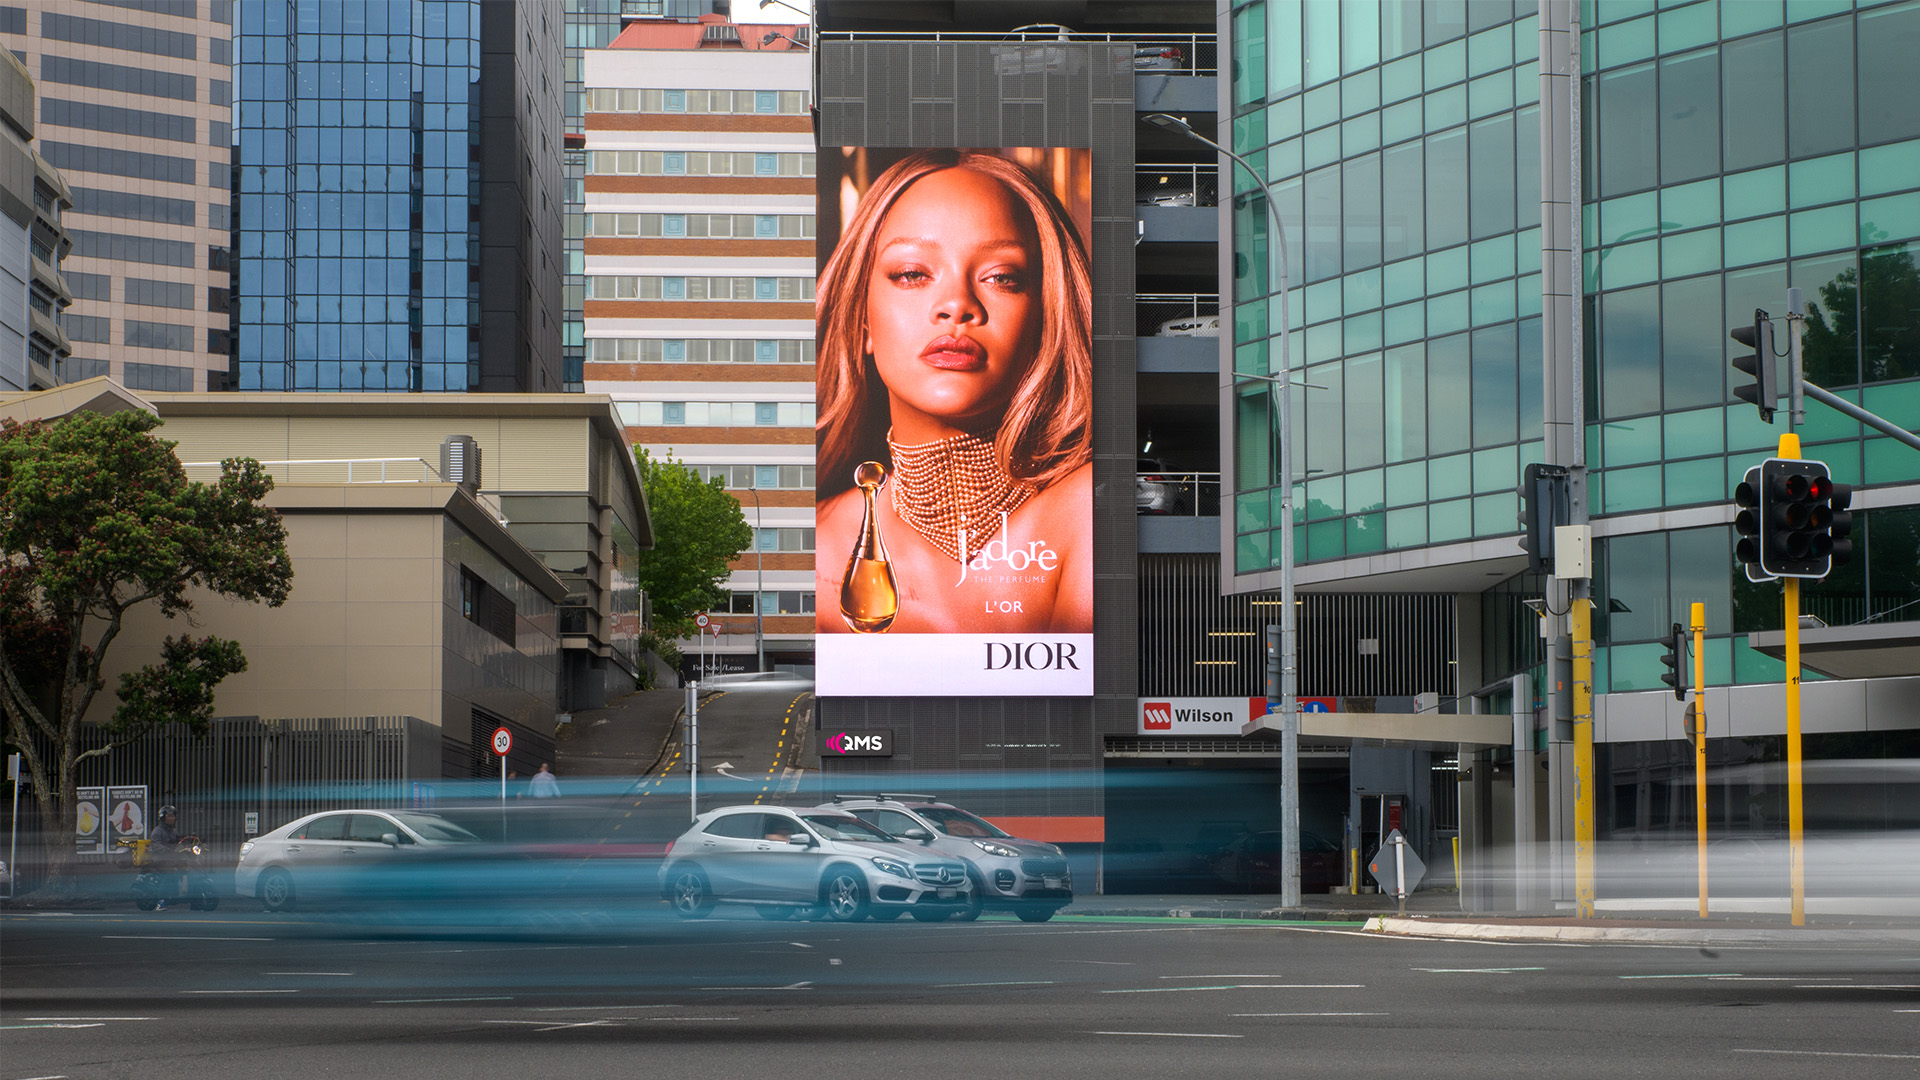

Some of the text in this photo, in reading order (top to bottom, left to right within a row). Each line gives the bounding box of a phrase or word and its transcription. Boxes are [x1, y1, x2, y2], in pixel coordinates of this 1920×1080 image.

[955, 511, 1058, 588] j'adore
[973, 575, 1046, 583] THE PERFUME
[985, 600, 1023, 613] L'OR
[983, 641, 1081, 670] DIOR
[1583, 686, 1591, 694] 10
[1174, 708, 1233, 722] Wilson
[496, 736, 508, 748] 30
[835, 734, 883, 753] QMS
